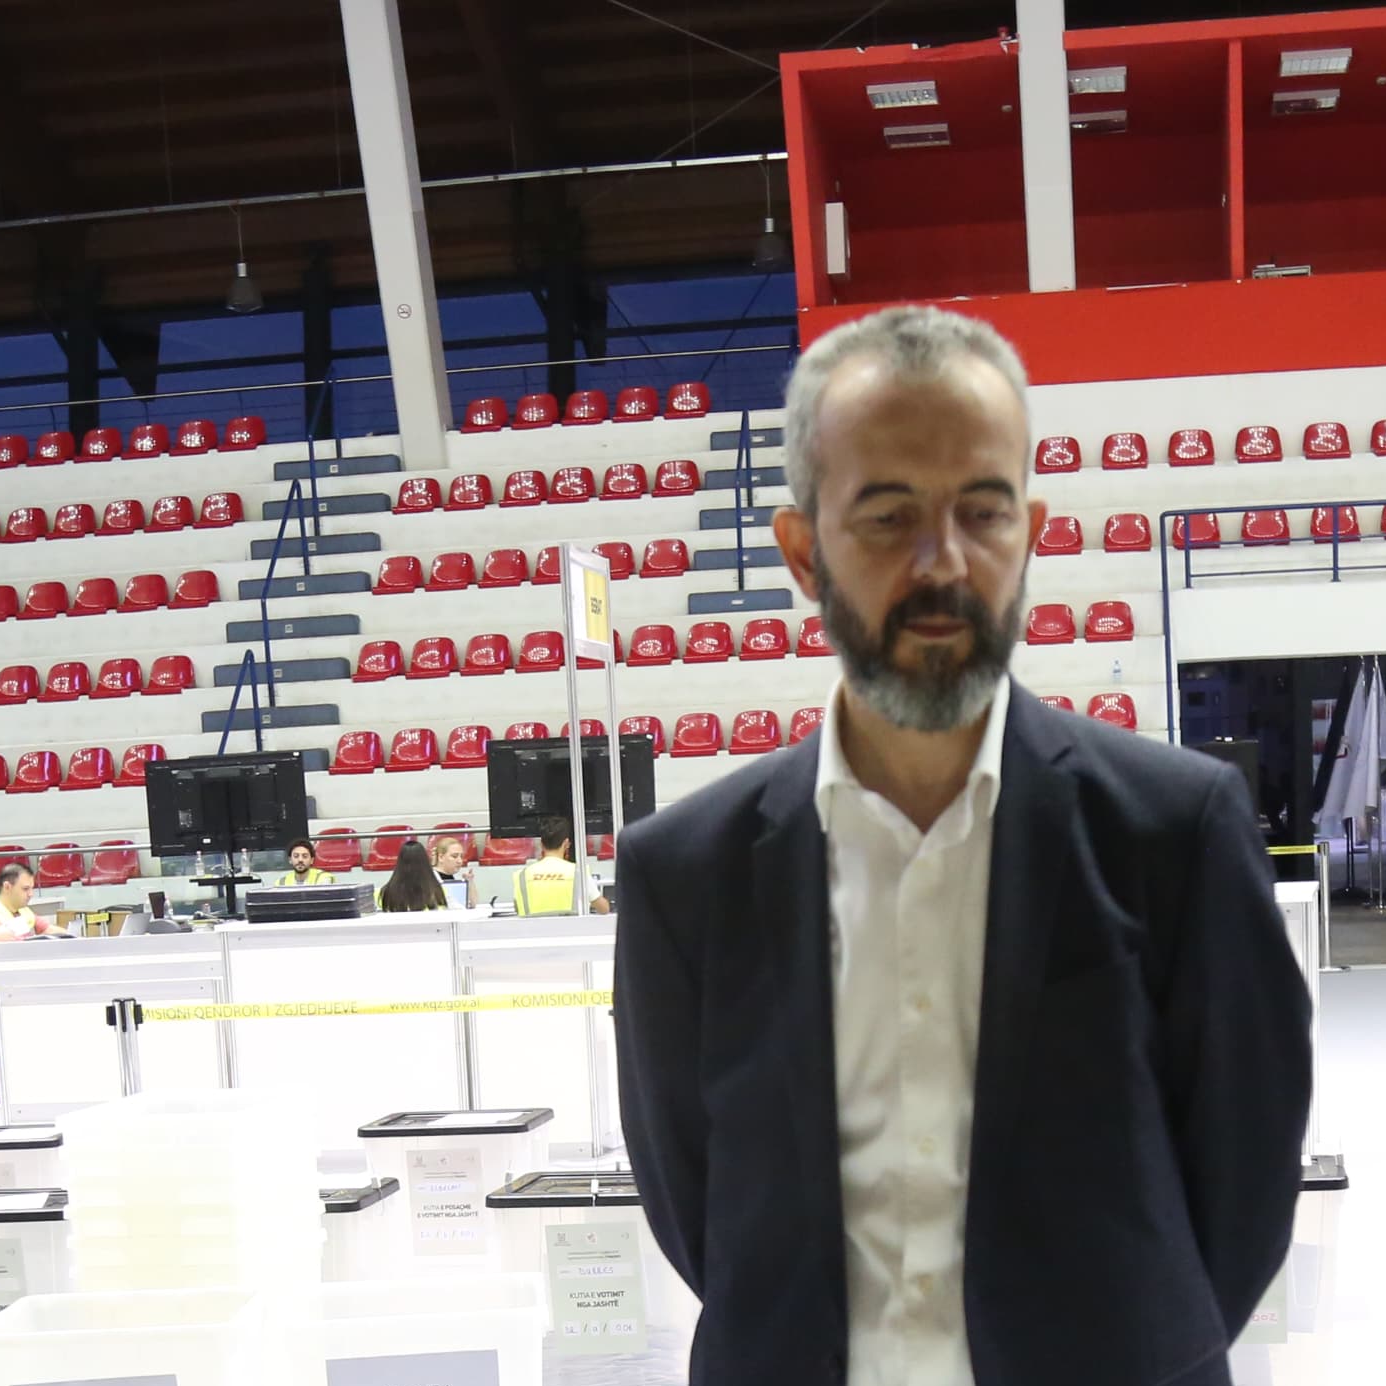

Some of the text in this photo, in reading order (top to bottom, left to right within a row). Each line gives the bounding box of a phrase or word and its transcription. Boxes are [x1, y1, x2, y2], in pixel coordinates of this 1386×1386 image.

[194, 1004, 260, 1020] QENDROR
[275, 1002, 358, 1016] ZGJEDHJEVE
[513, 993, 587, 1008] KOMISIONI
[596, 1290, 625, 1298] VOTIMIT
